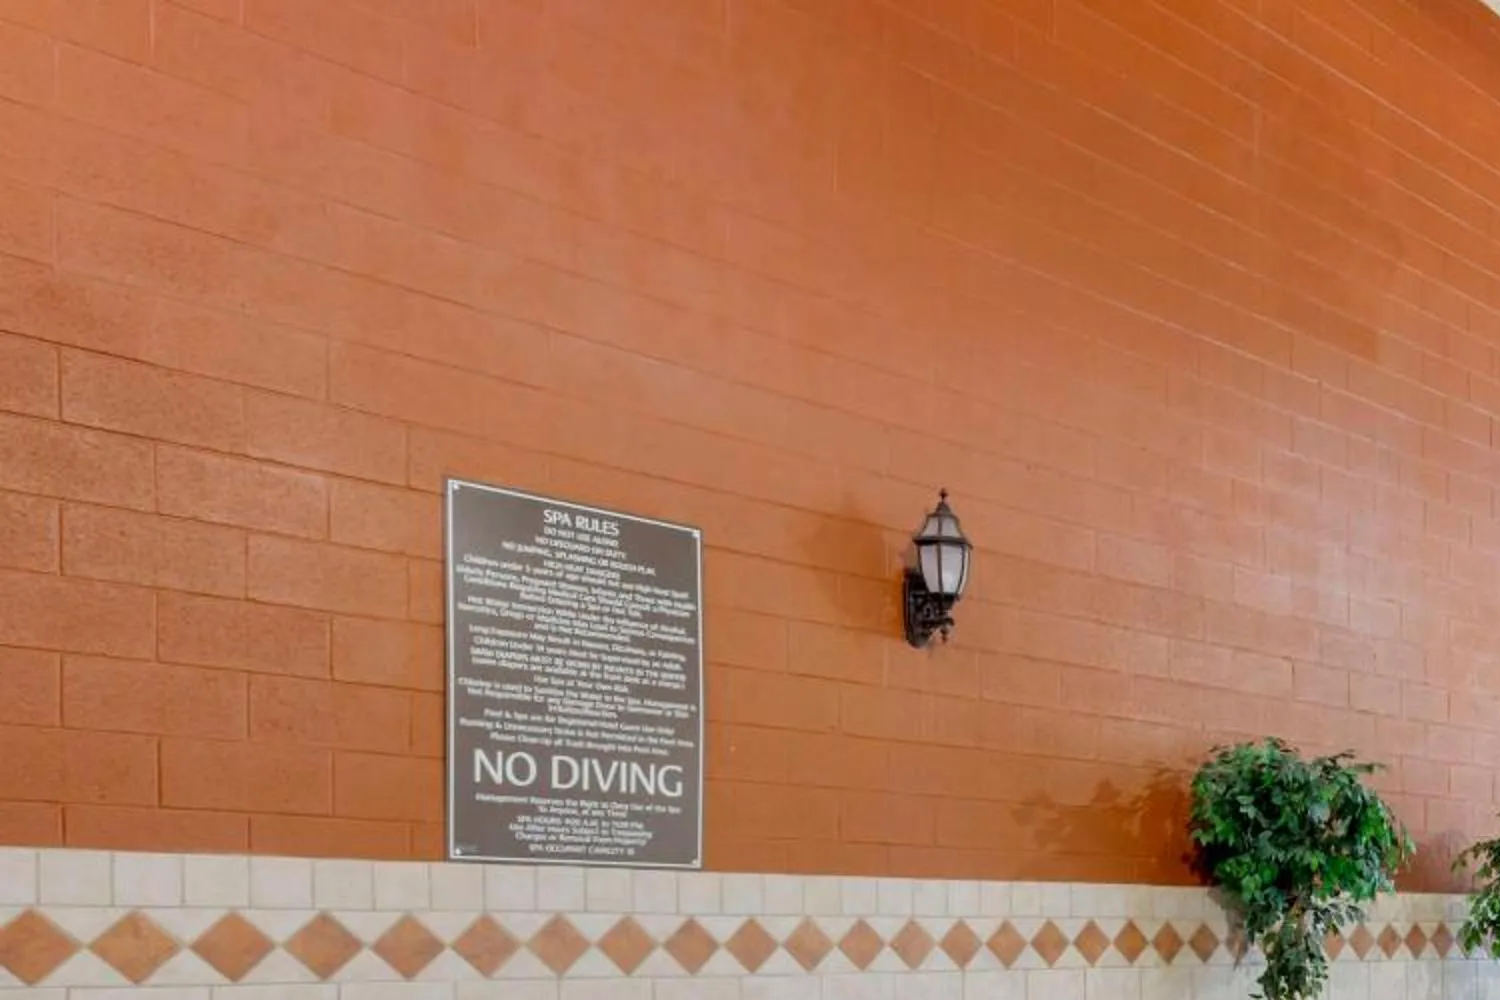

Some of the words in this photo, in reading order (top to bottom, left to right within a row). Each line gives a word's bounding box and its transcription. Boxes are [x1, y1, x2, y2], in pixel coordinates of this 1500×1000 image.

[543, 508, 572, 526] SPA
[575, 515, 619, 536] RULES
[473, 748, 537, 787] NO
[551, 755, 684, 798] DIVING
